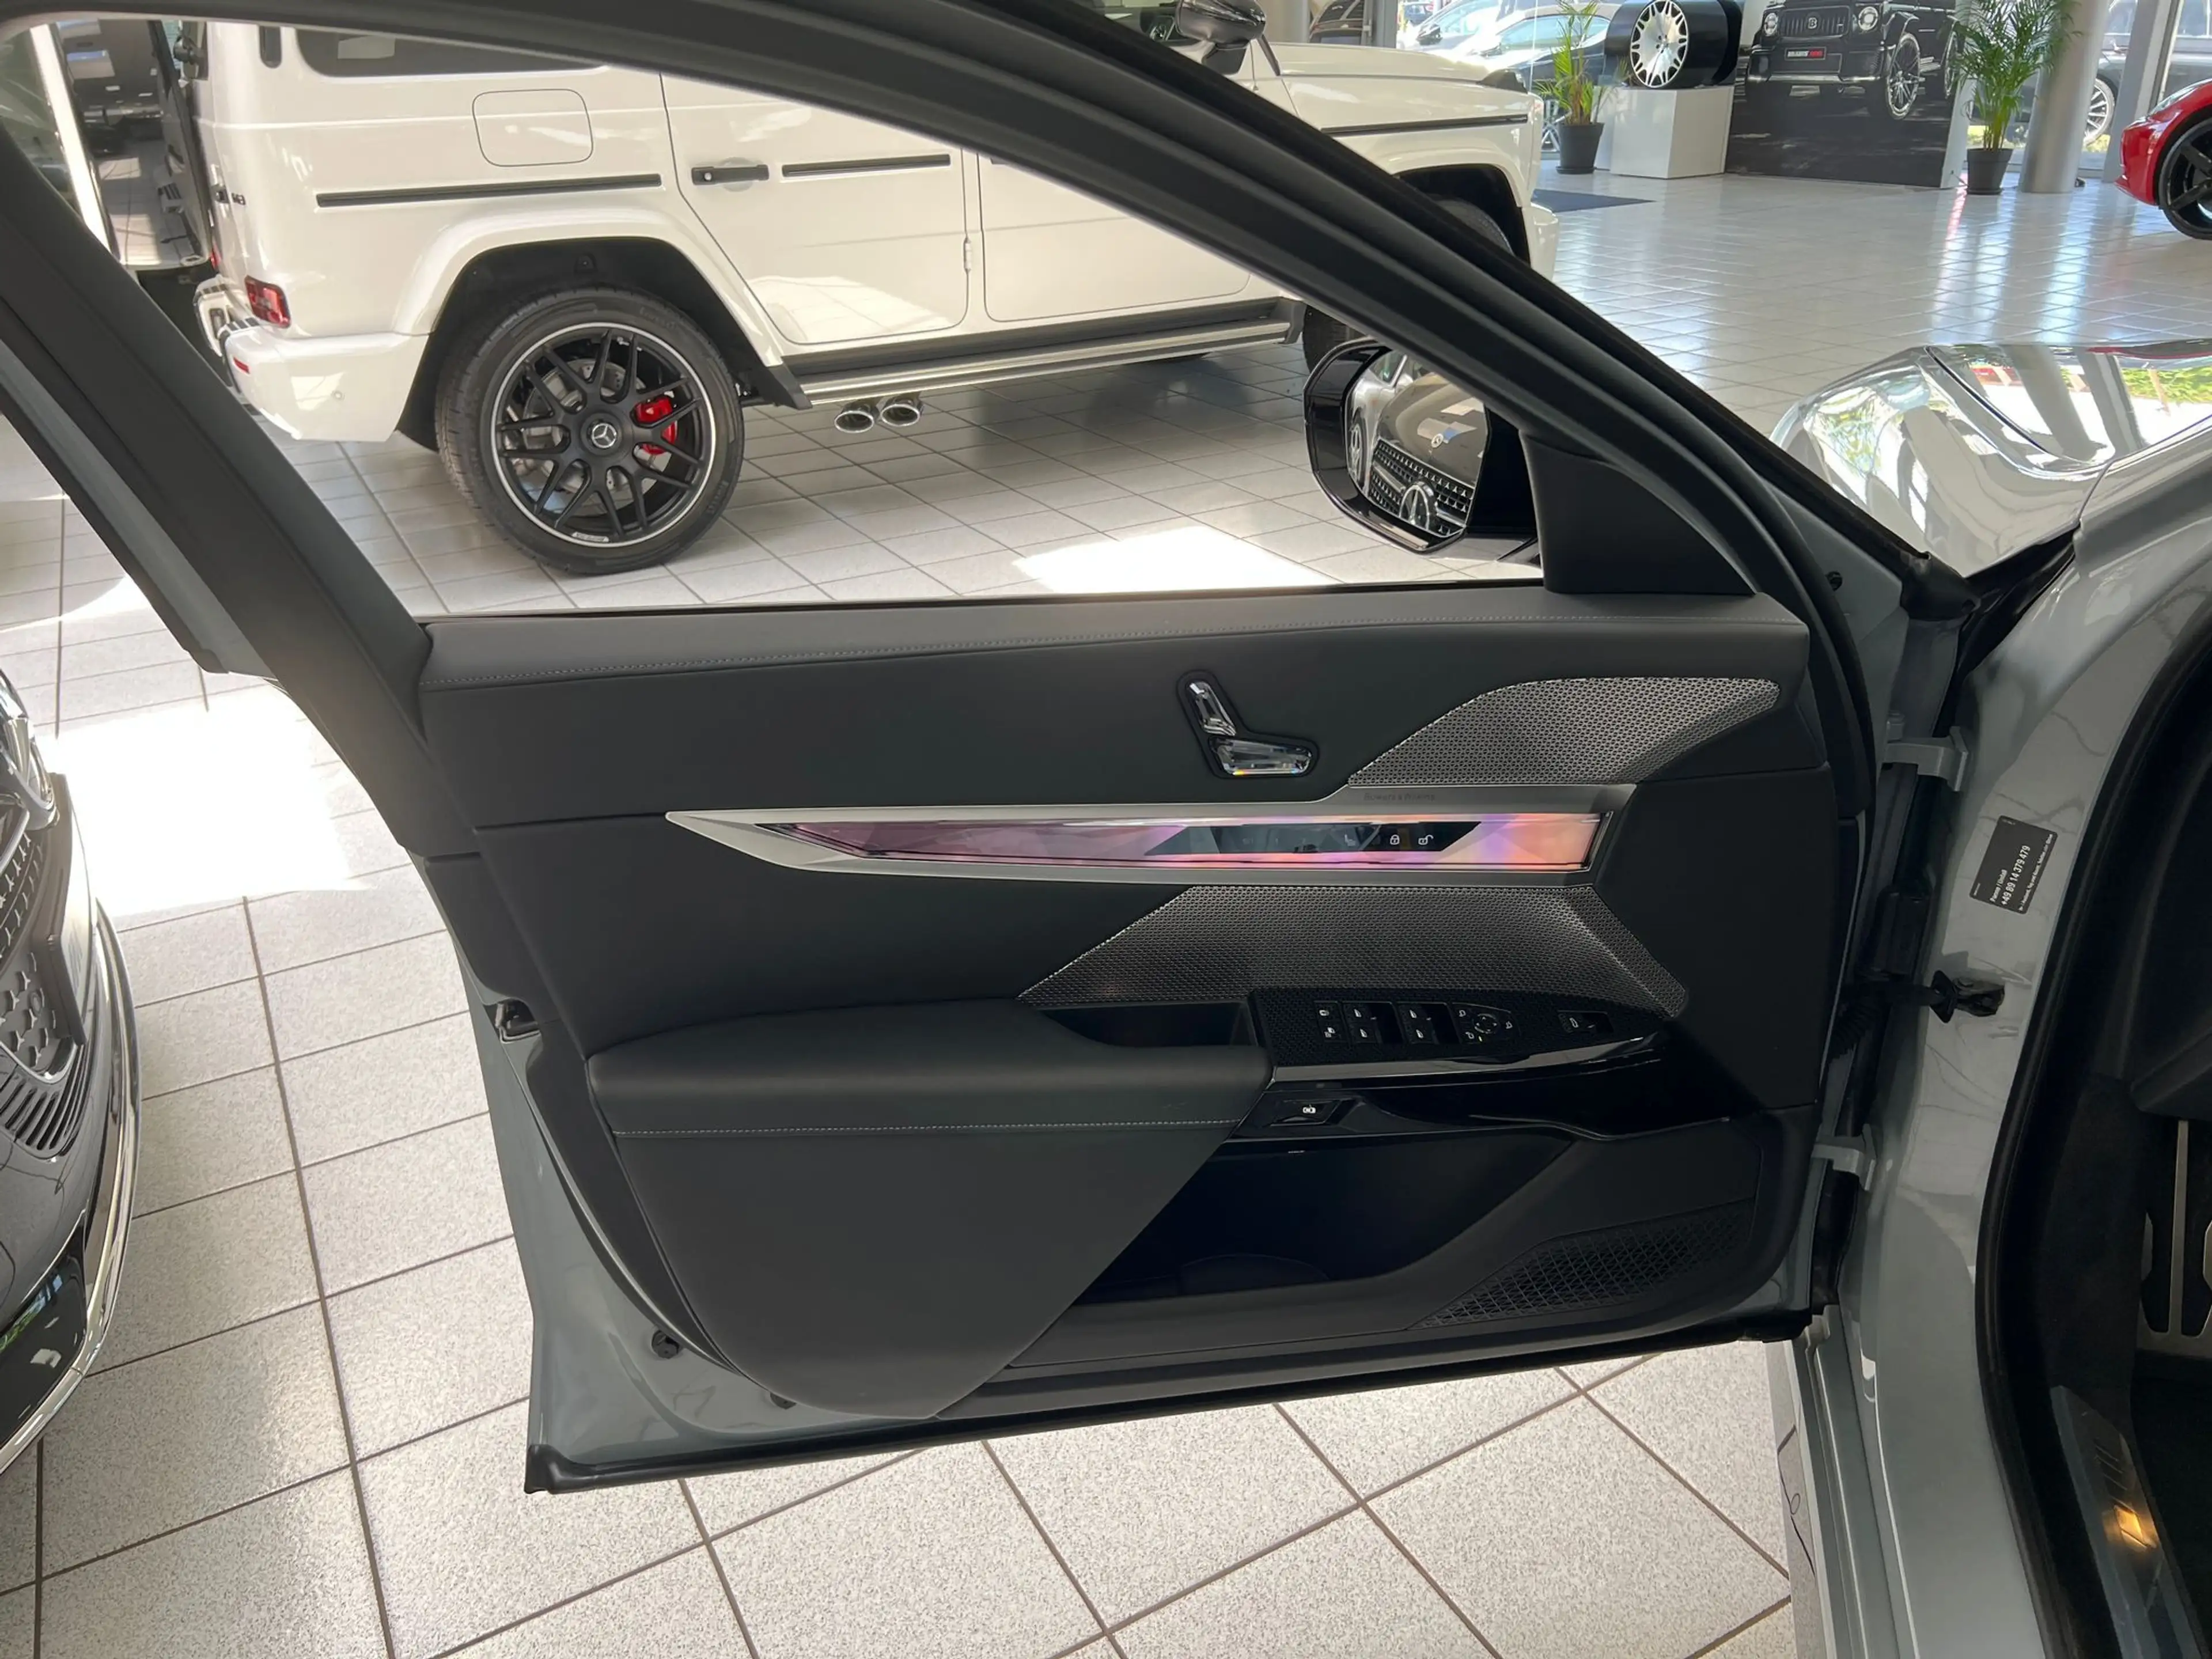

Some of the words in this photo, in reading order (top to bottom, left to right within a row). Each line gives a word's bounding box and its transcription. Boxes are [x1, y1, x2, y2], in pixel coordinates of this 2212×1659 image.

[2019, 845, 2031, 859] 479
[2013, 858, 2025, 873] 379
[2010, 873, 2020, 881] 14
[2006, 882, 2016, 892] 89
[2001, 892, 2012, 905] +49
